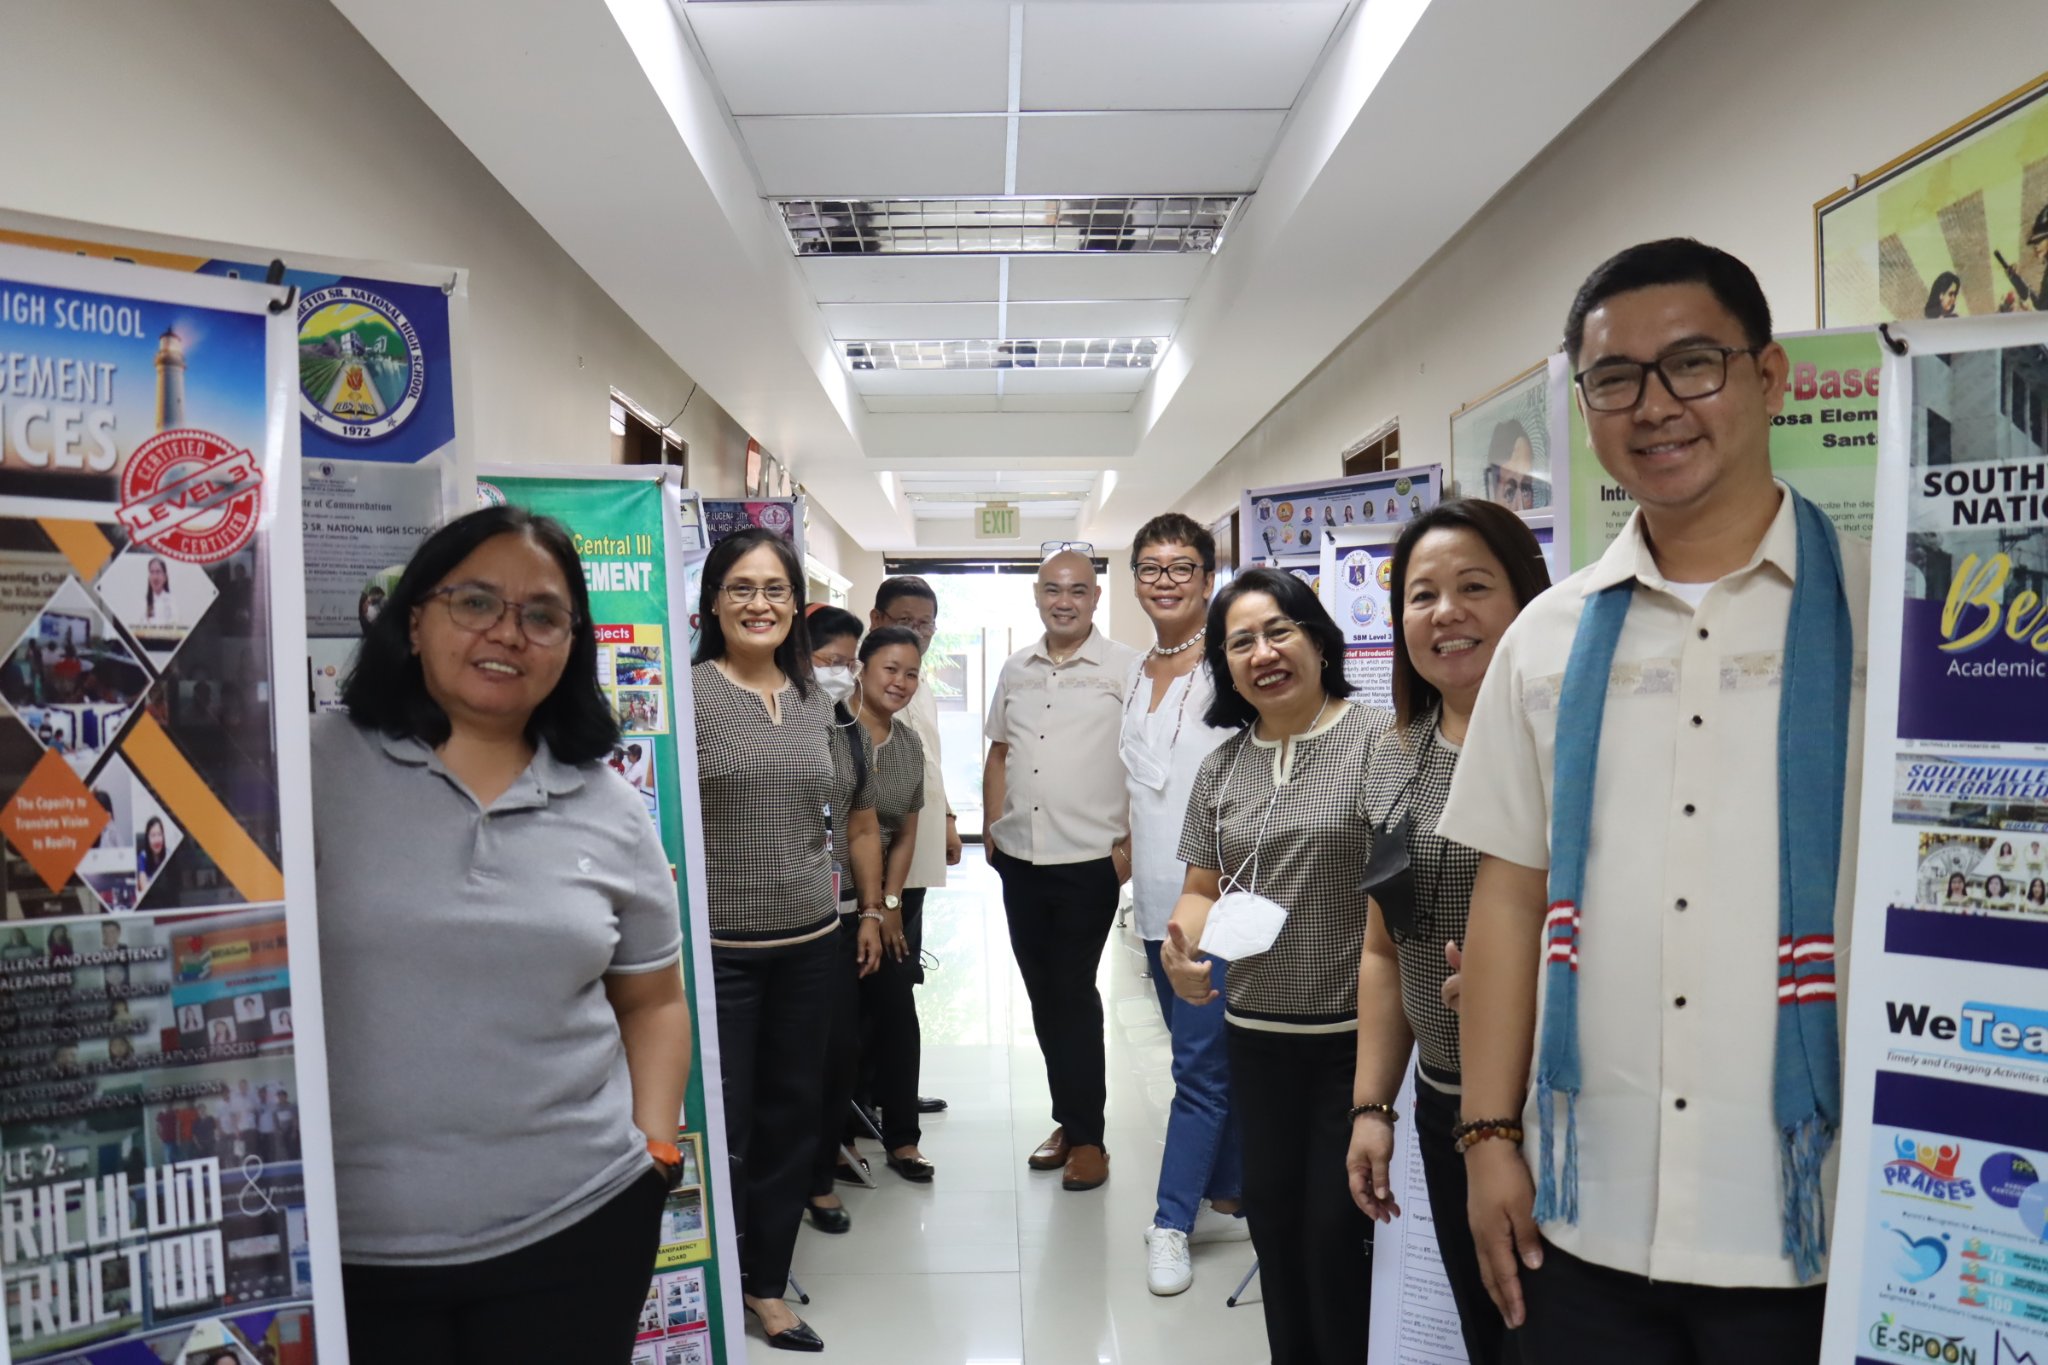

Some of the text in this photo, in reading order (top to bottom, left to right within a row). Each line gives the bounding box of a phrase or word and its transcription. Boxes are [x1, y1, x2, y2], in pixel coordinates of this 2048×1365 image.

[327, 288, 348, 299] SR.
[351, 288, 401, 323] NATIONAL
[54, 297, 146, 339] SCHOOL
[400, 321, 420, 355] HIGH
[406, 355, 424, 400] SCHOOL
[342, 425, 372, 438] 1972
[1822, 431, 1878, 448] Sant
[136, 439, 207, 482] CERTIFIED
[1923, 463, 2048, 498] SOUTH
[131, 464, 250, 530] LEVEL 3
[325, 500, 392, 511] Commendation
[1843, 501, 1857, 509] the
[1952, 494, 2048, 526] NATI
[180, 511, 249, 555] CERTIFIED
[326, 523, 374, 534] NATIONAL
[376, 525, 400, 535] HIGH
[718, 523, 732, 532] HIGH
[982, 510, 1014, 534] EXIT
[1843, 523, 1860, 532] that
[573, 533, 652, 556] Central III
[1369, 633, 1387, 641] Level
[1344, 650, 1358, 658] rief
[1946, 657, 2047, 678] Academic
[1907, 762, 2048, 784] SOUTHVILLE
[1906, 777, 2048, 799] INTEGRATED
[16, 796, 88, 813] The Capacity to
[16, 815, 90, 831] Translate Vision
[33, 837, 78, 851] to Reality
[53, 953, 83, 968] AND
[83, 945, 165, 965] COMPETENCE
[1886, 1051, 2040, 1083] Timely and Engaging Activities
[1, 1143, 66, 1183] LE 2:
[238, 1154, 279, 1217] &
[1883, 1164, 1977, 1201] PRAISES
[667, 1254, 687, 1262] BOARD
[1876, 1325, 1977, 1365] E-SPOON
